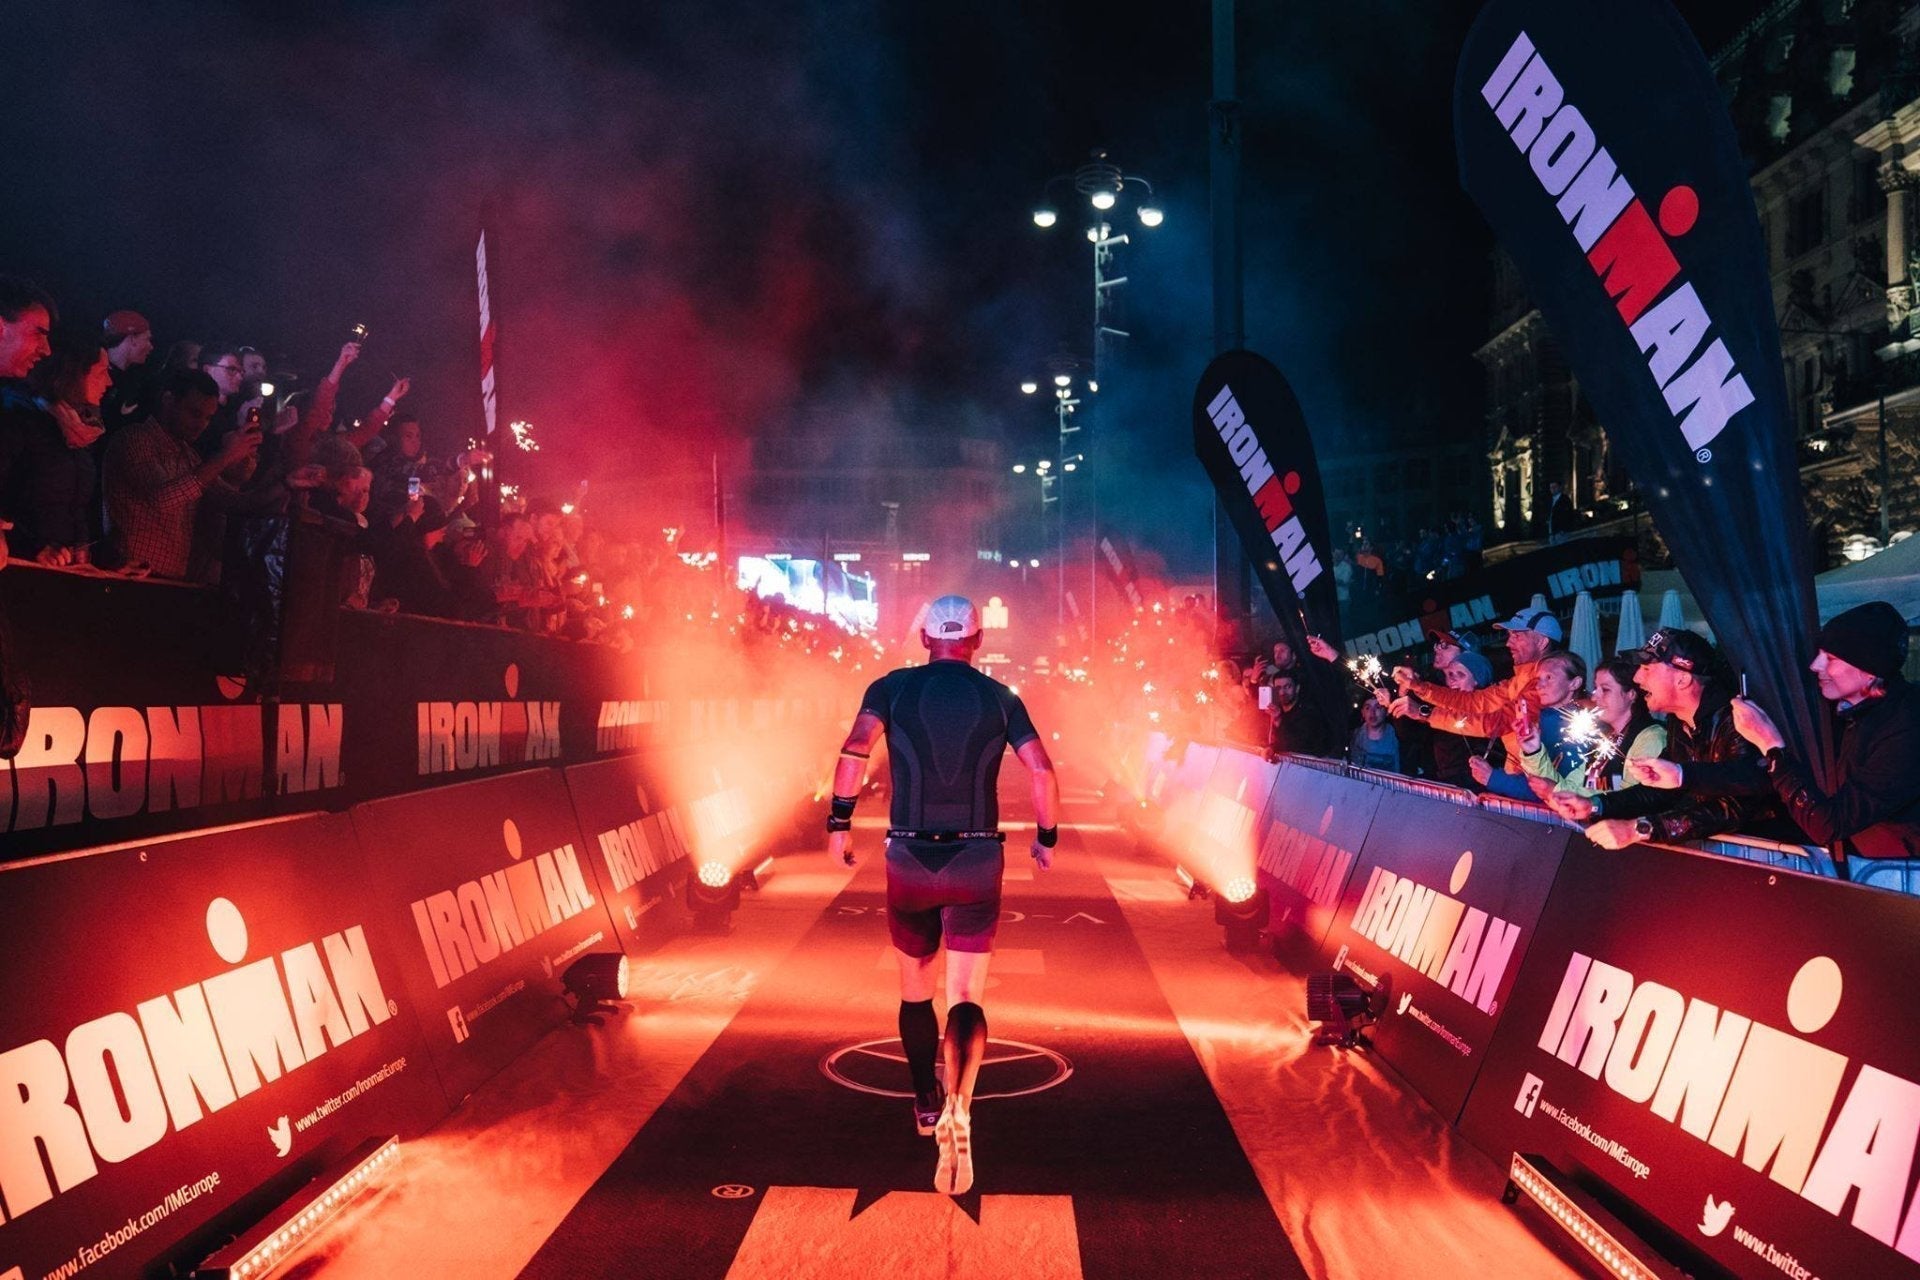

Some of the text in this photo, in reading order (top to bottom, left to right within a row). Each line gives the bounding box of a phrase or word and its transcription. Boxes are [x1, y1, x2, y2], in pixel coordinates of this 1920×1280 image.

[1481, 30, 1755, 452] IRONMAN
[1206, 384, 1323, 594] IRONMAN
[418, 702, 560, 775] IRONMAN
[411, 844, 594, 989] IRONMAN
[1350, 866, 1521, 1014] IRONMAN
[0, 925, 391, 1224] RONMAN
[295, 1057, 407, 1132] www.twitter.com/IronmanEurope
[1538, 952, 1920, 1264] IRONMA
[1540, 1099, 1650, 1179] www.facebook.com/IMEurope
[43, 1171, 220, 1280] ww.facebook.com/IMEurope
